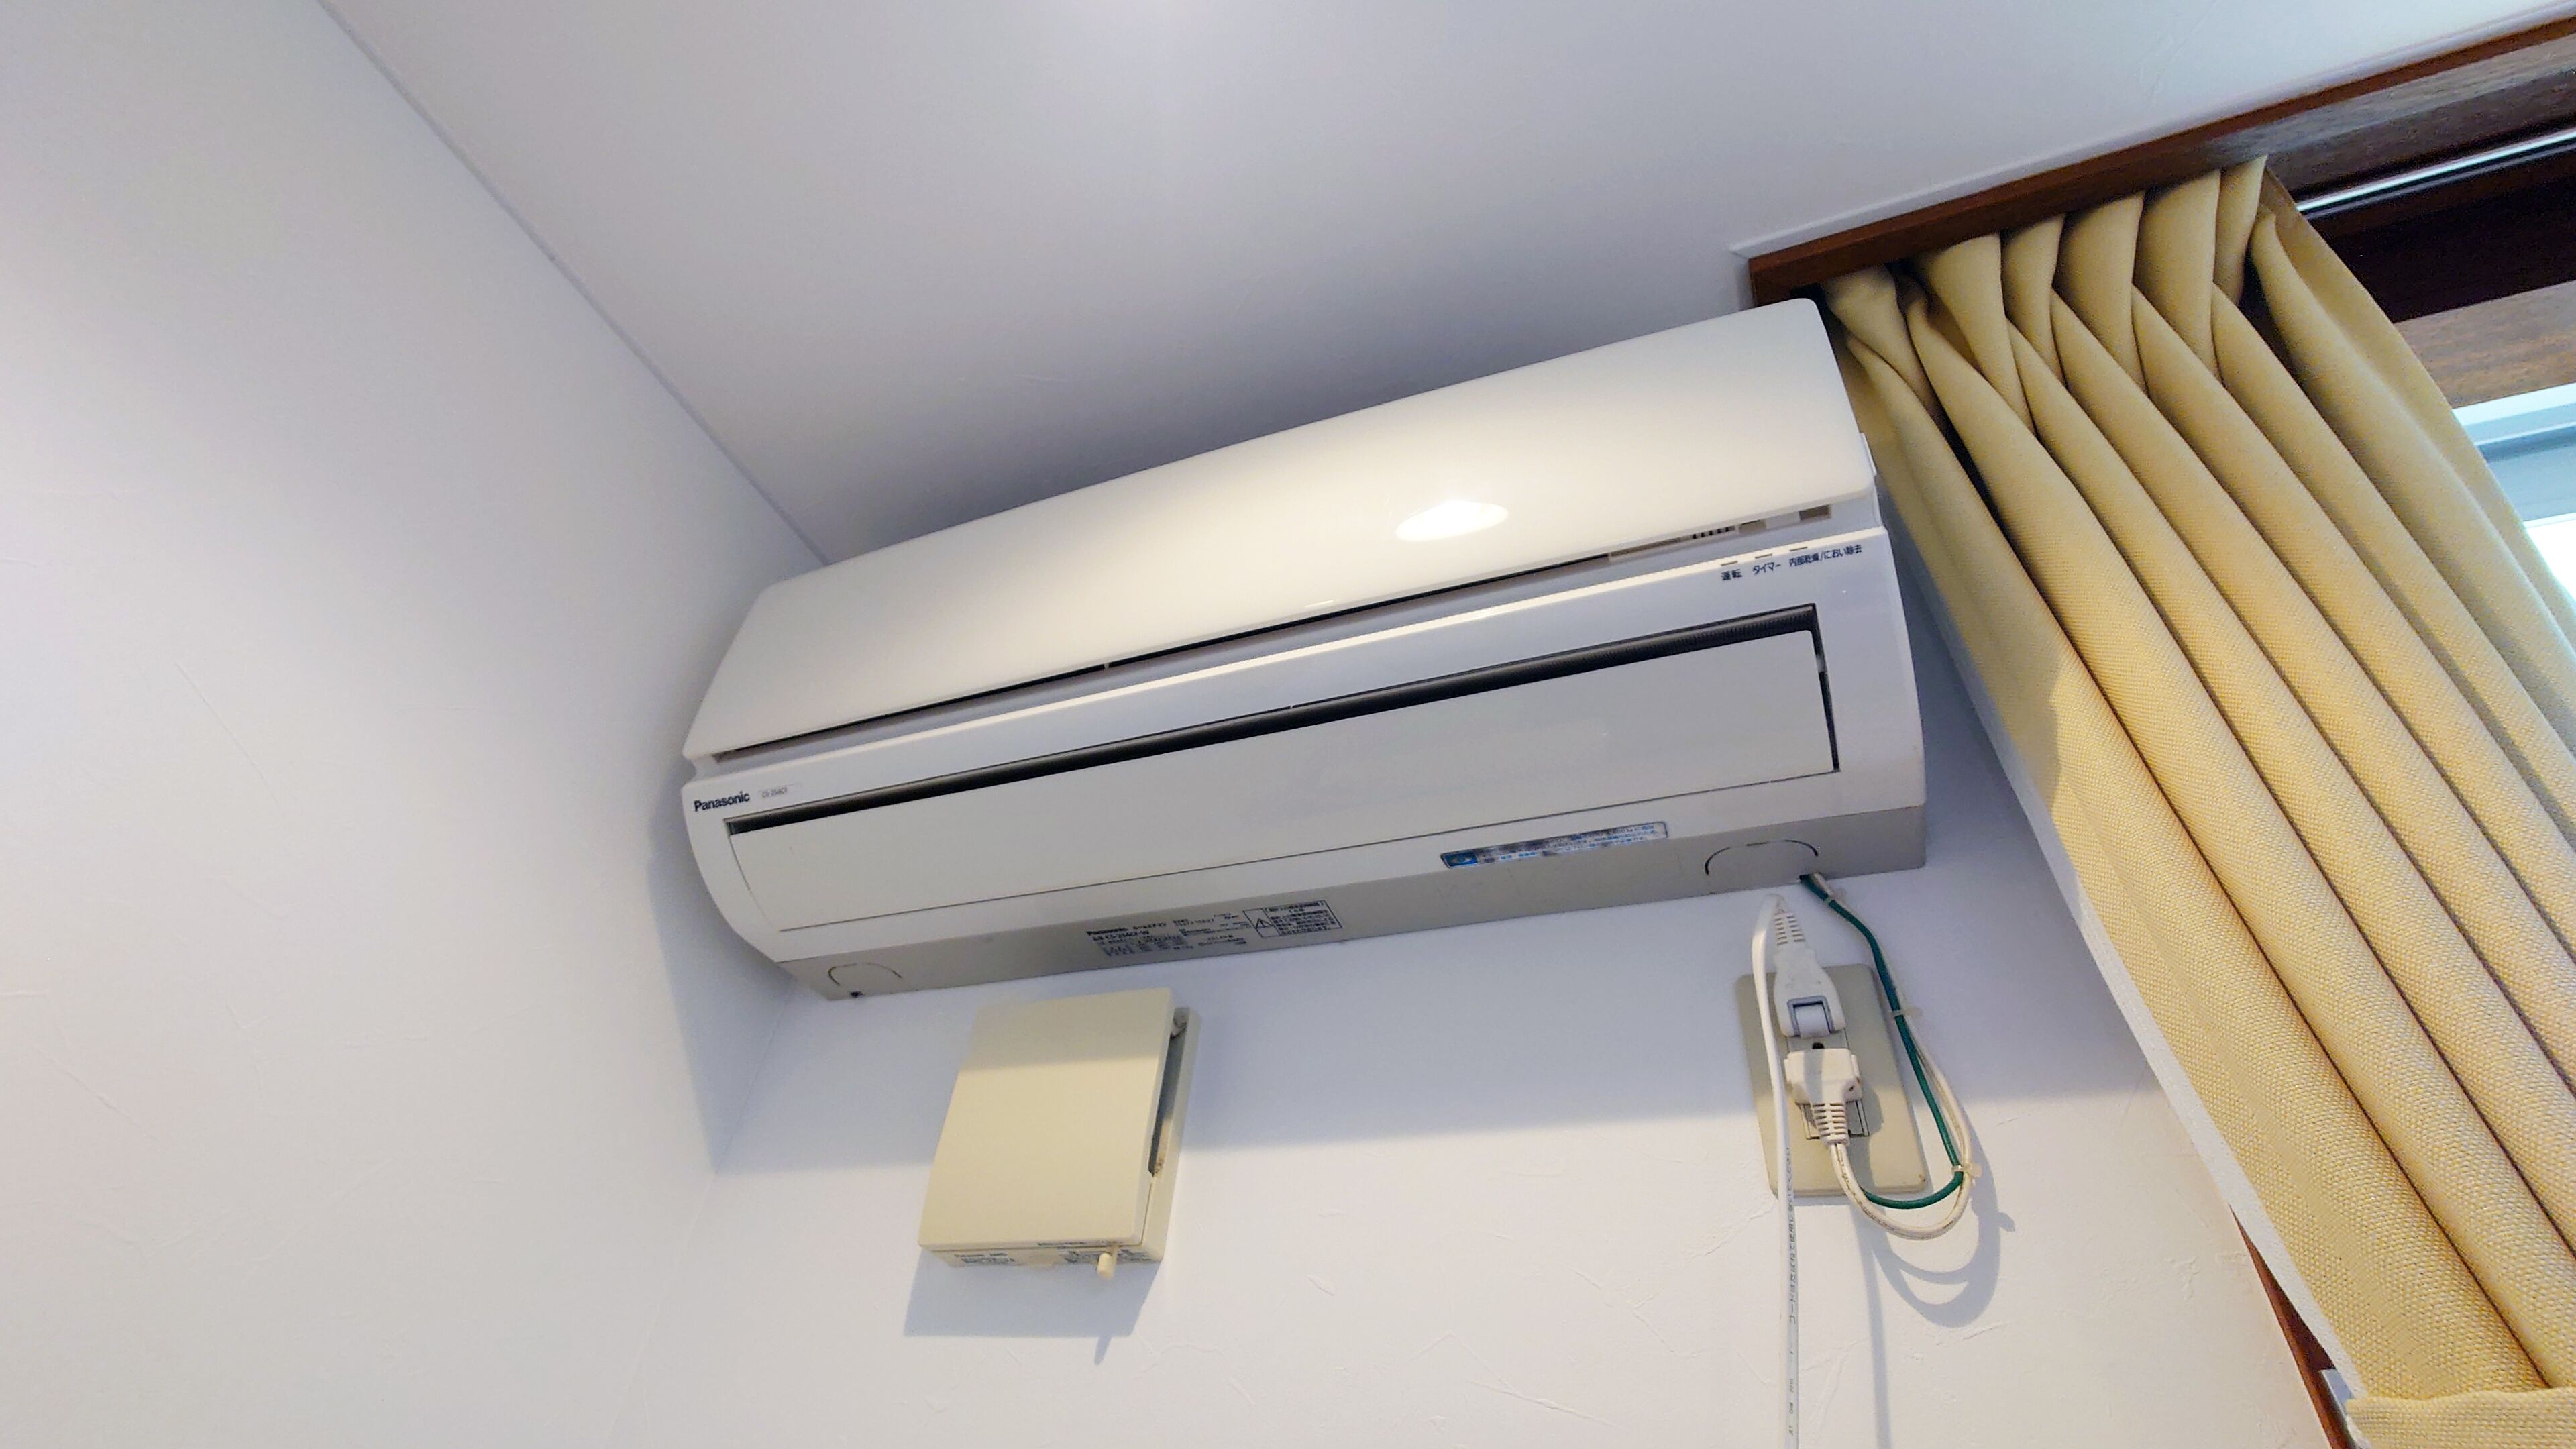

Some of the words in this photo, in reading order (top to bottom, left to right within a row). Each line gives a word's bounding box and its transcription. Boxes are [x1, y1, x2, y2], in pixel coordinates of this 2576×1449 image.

[1721, 568, 1743, 581] 運転
[1752, 561, 1781, 575] タイマー
[1789, 545, 1862, 567] 内部乾燥/におい除去
[694, 790, 751, 812] Panasonic
